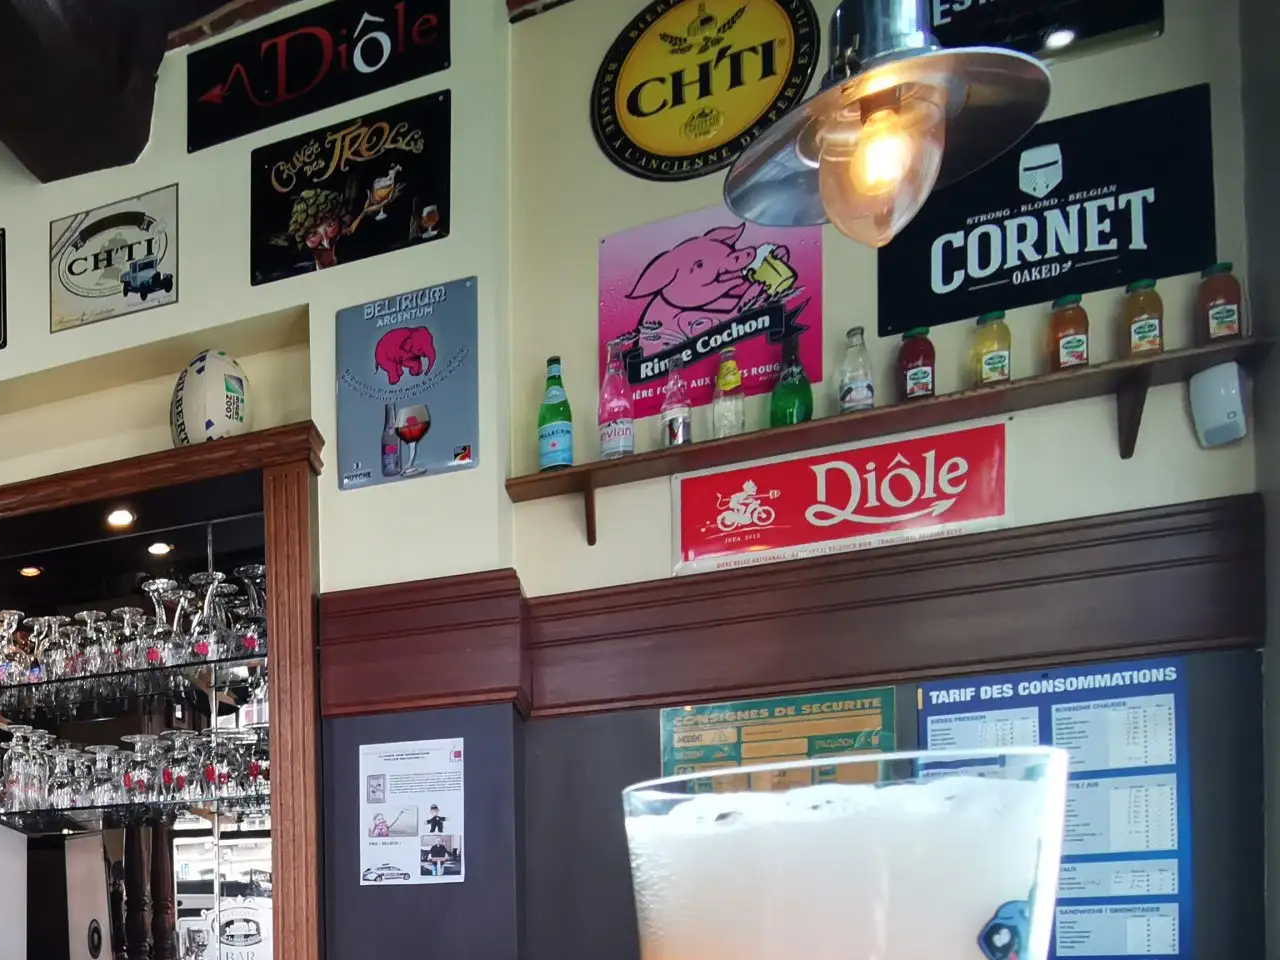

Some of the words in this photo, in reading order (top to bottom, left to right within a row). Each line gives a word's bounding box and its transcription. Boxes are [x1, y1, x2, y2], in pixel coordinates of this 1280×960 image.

[260, 1, 439, 104] Diôle
[966, 207, 1011, 226] STRONG
[1020, 197, 1059, 213] BLOND
[1068, 184, 1118, 201] BELGIAN
[930, 187, 1155, 295] CORNET
[1012, 261, 1061, 285] OAKED
[363, 284, 448, 320] DELIRIUM
[376, 305, 434, 328] ARGENTUM
[640, 348, 693, 380] Rine
[695, 314, 771, 354] Cochon
[690, 376, 711, 389] AUX
[225, 394, 233, 419] 2007
[805, 449, 969, 526] Diôle
[929, 685, 976, 705] TARIF
[980, 682, 1014, 700] DES
[1017, 667, 1177, 697] CONSOMMATIONS
[672, 708, 769, 727] CONSIGNES
[774, 705, 796, 717] DE
